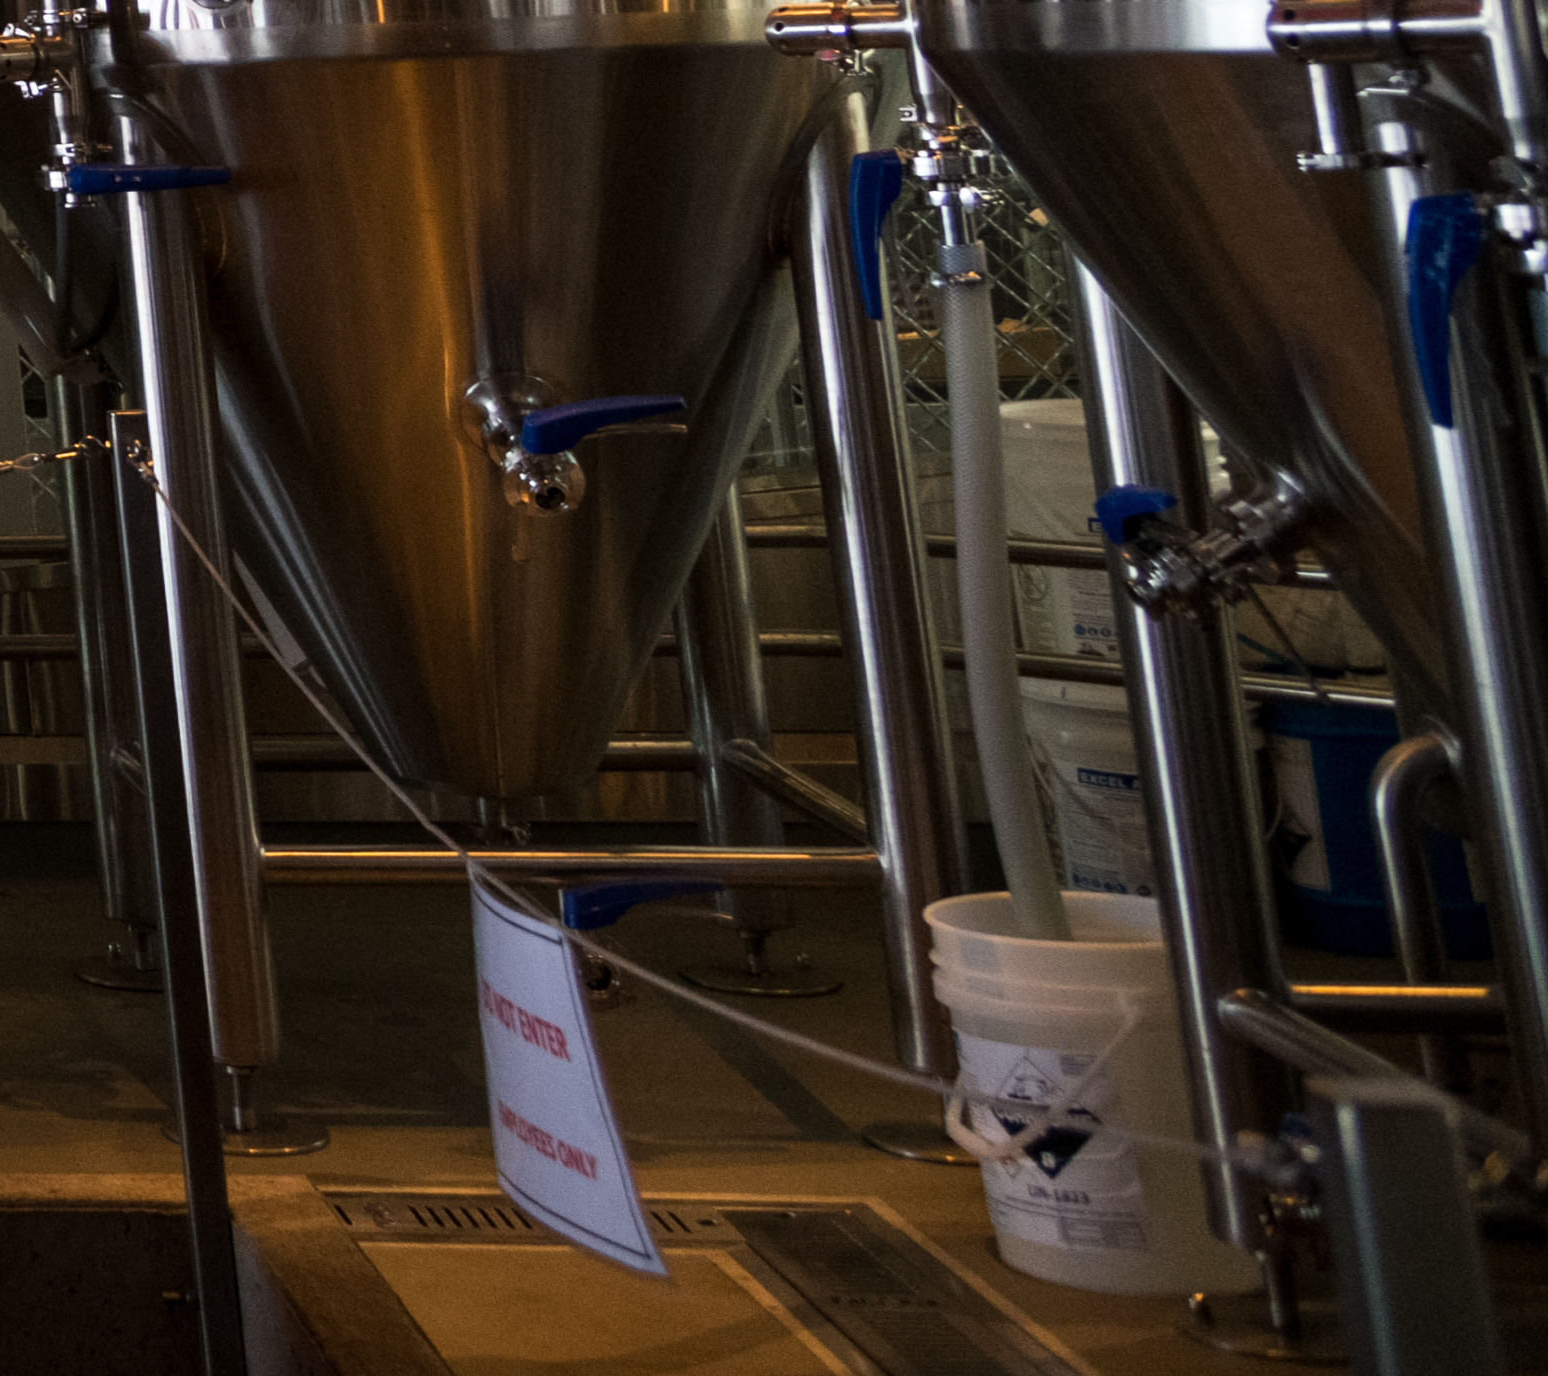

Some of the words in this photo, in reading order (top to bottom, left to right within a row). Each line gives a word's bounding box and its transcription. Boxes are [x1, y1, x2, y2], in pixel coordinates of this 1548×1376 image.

[492, 991, 518, 1034] NOT
[517, 1006, 571, 1063] ENTER
[557, 1138, 598, 1181] ONLY
